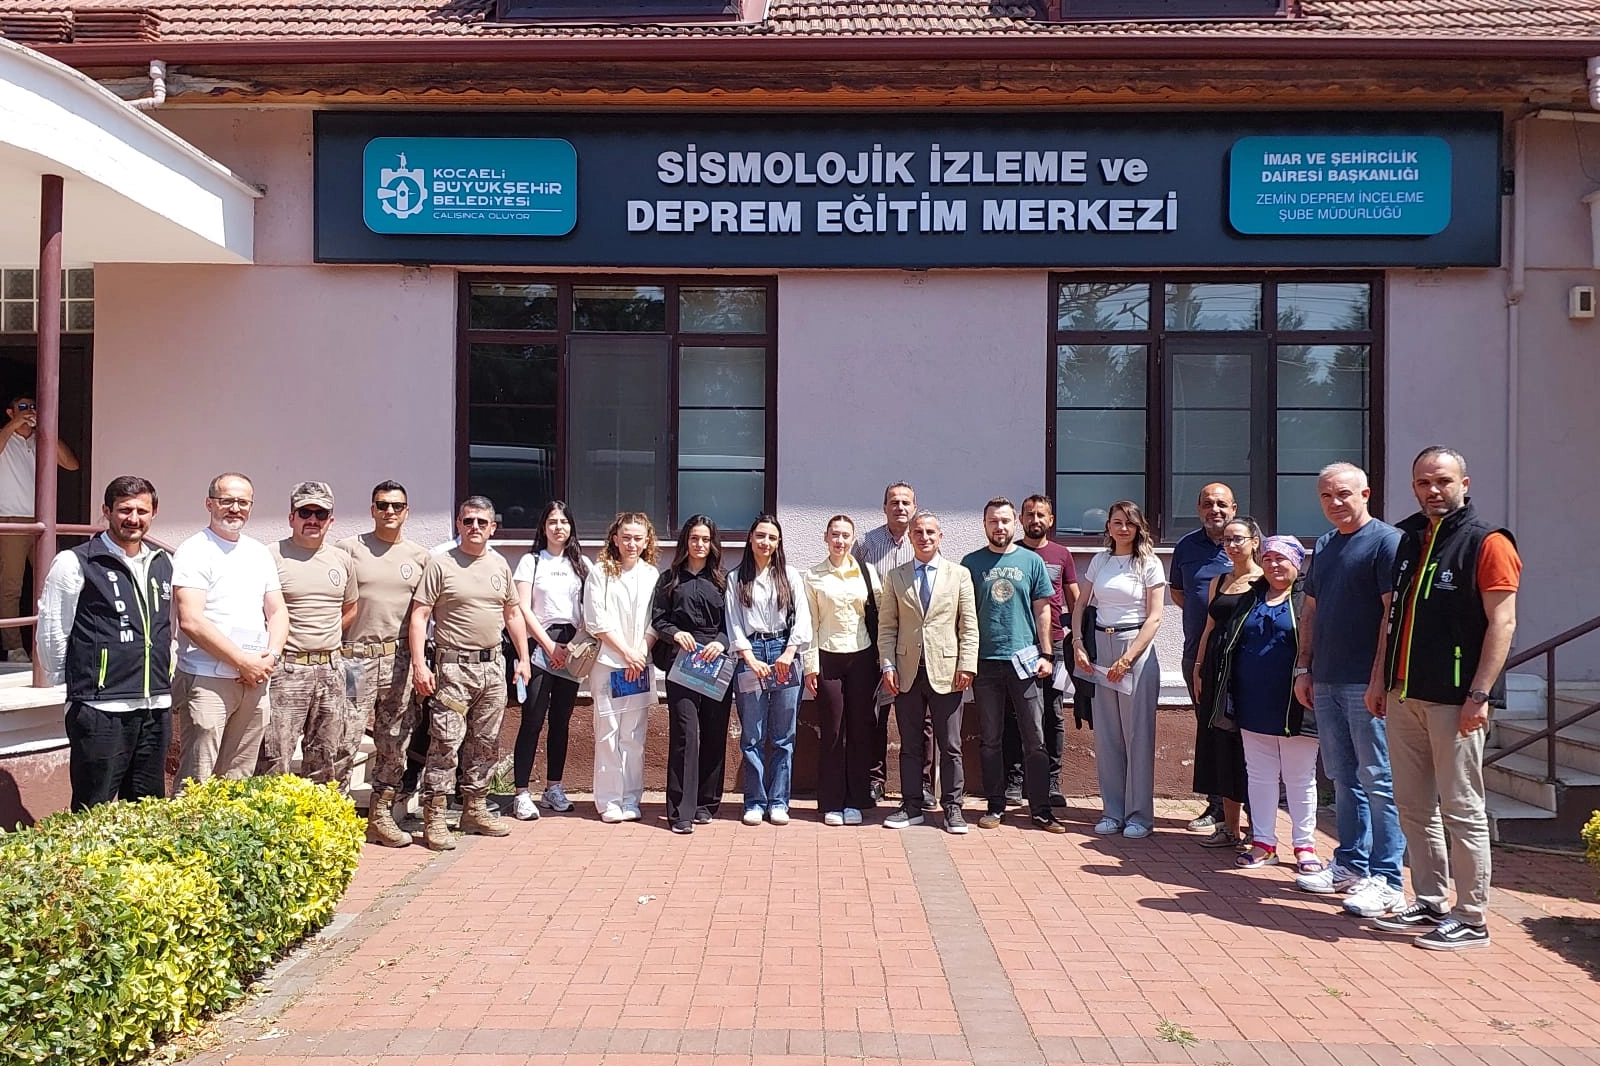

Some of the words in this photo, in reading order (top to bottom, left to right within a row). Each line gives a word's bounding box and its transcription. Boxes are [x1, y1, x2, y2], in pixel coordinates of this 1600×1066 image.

[657, 143, 915, 184] SİSMOLOJİK
[930, 143, 1088, 183] İZLEME
[1100, 157, 1149, 183] ve
[1263, 152, 1302, 165] İMAR
[1306, 152, 1326, 165] VE
[1331, 149, 1418, 167] ŞEHİRCİLİK
[1261, 168, 1323, 183] DAİRESİ
[1328, 166, 1419, 184] BAŞKANLIĞI
[1256, 191, 1297, 205] ZEMİN
[1300, 192, 1355, 204] DEPREM
[1358, 189, 1425, 203] İNCELEME
[488, 212, 530, 220] OLUYOR
[627, 200, 802, 232] DEPREM
[817, 191, 967, 233] EĞİTİM
[983, 190, 1178, 231] MERKEZİ
[1279, 208, 1314, 223] ŞUBE
[1317, 205, 1402, 219] MÜDÜRLÜĞÜ
